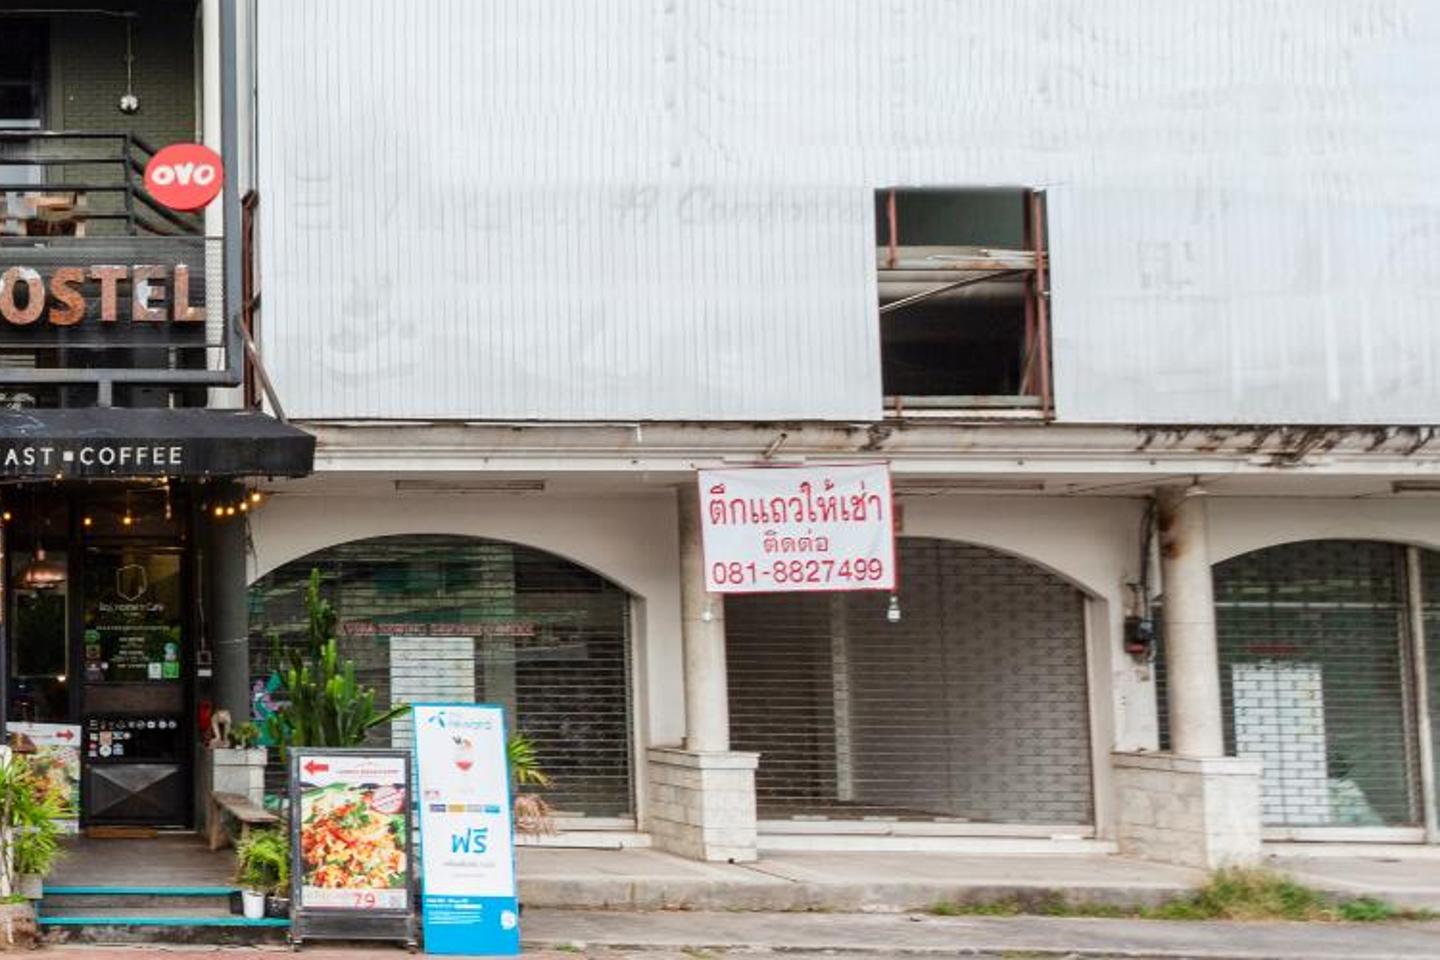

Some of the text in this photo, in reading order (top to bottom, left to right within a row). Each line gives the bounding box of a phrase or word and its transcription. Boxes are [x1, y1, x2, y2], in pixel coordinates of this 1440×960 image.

[79, 446, 183, 466] COFFEE
[709, 479, 882, 525] ตึกแถวให้เช่า
[763, 528, 829, 553] ติดต่อ
[713, 558, 883, 585] 081-8827499
[451, 828, 488, 853] ฟรี
